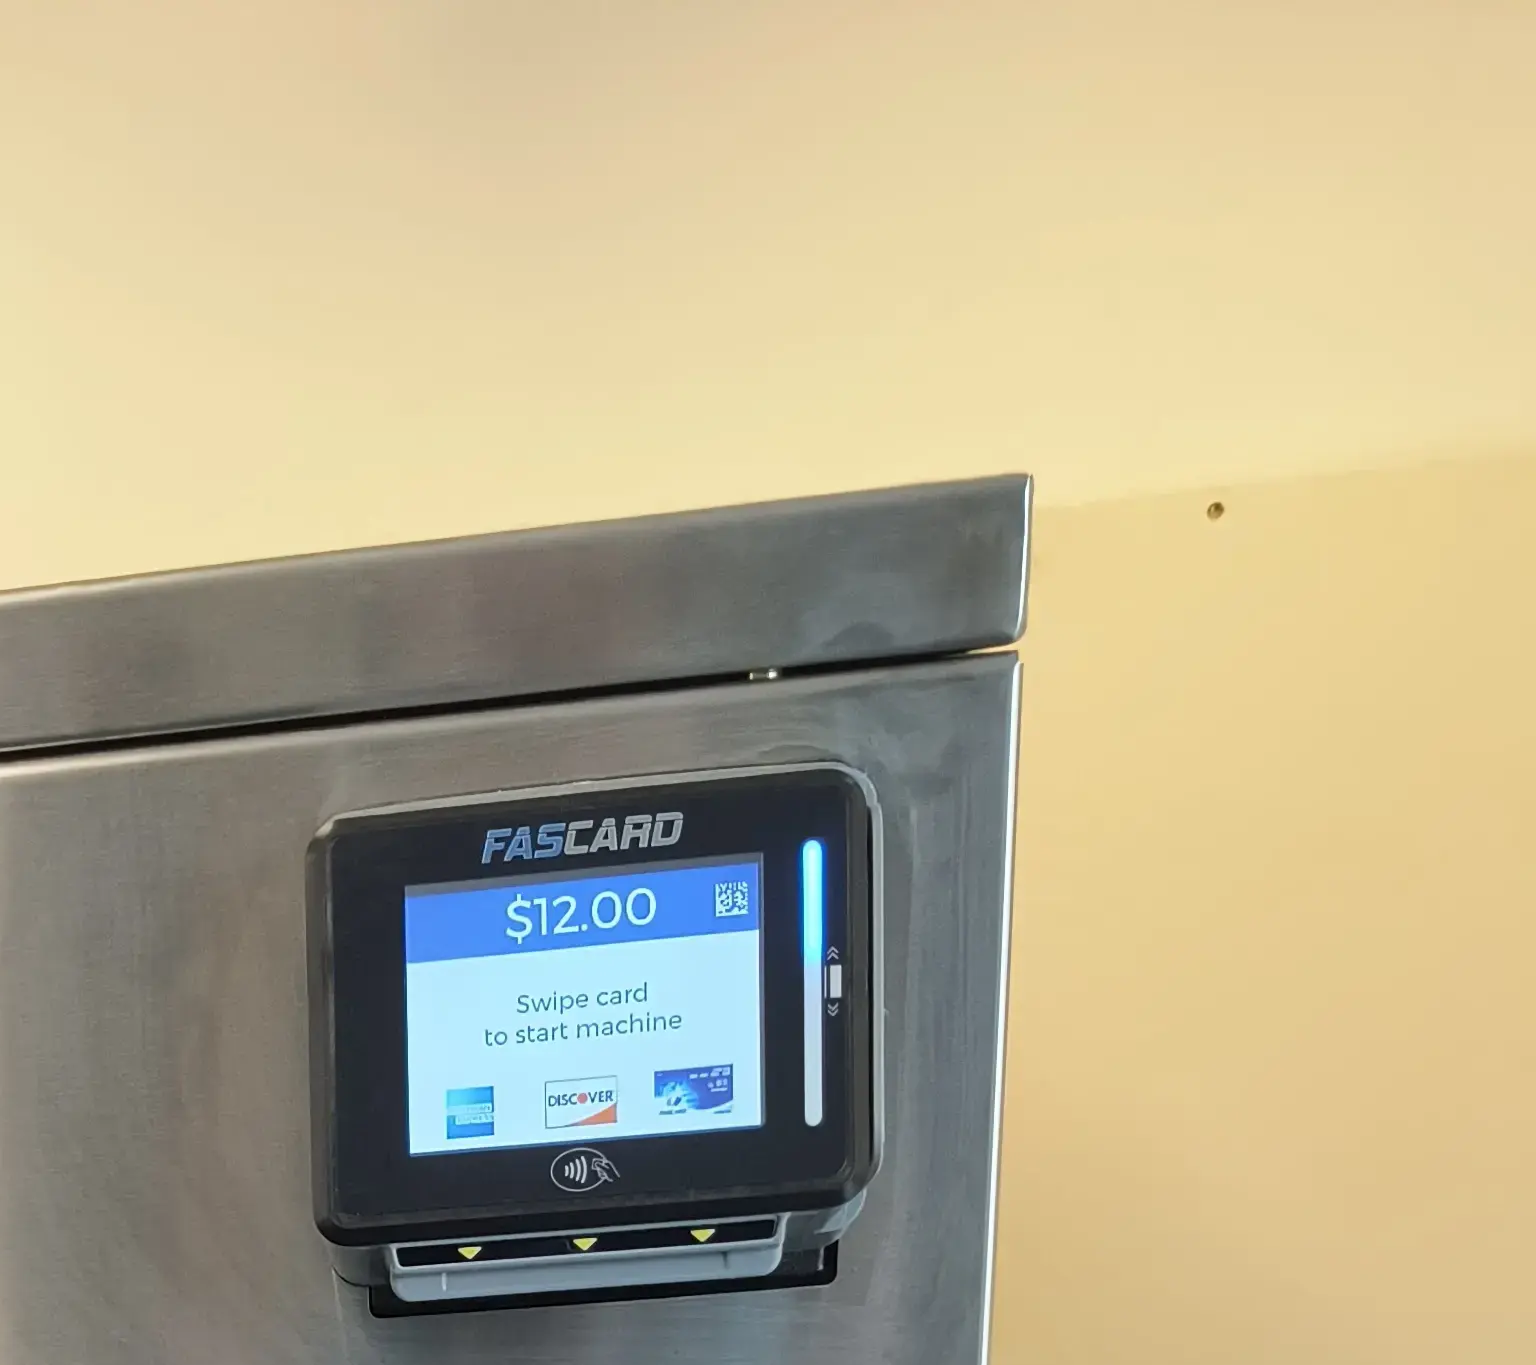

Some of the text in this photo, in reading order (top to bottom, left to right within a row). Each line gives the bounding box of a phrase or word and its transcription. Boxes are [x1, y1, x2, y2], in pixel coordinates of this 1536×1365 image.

[481, 811, 684, 864] FASCARD
[505, 887, 657, 945] $12.00
[516, 981, 648, 1015] Swipe card
[484, 1011, 683, 1047] to start machine
[547, 1089, 614, 1108] DISCOVER
